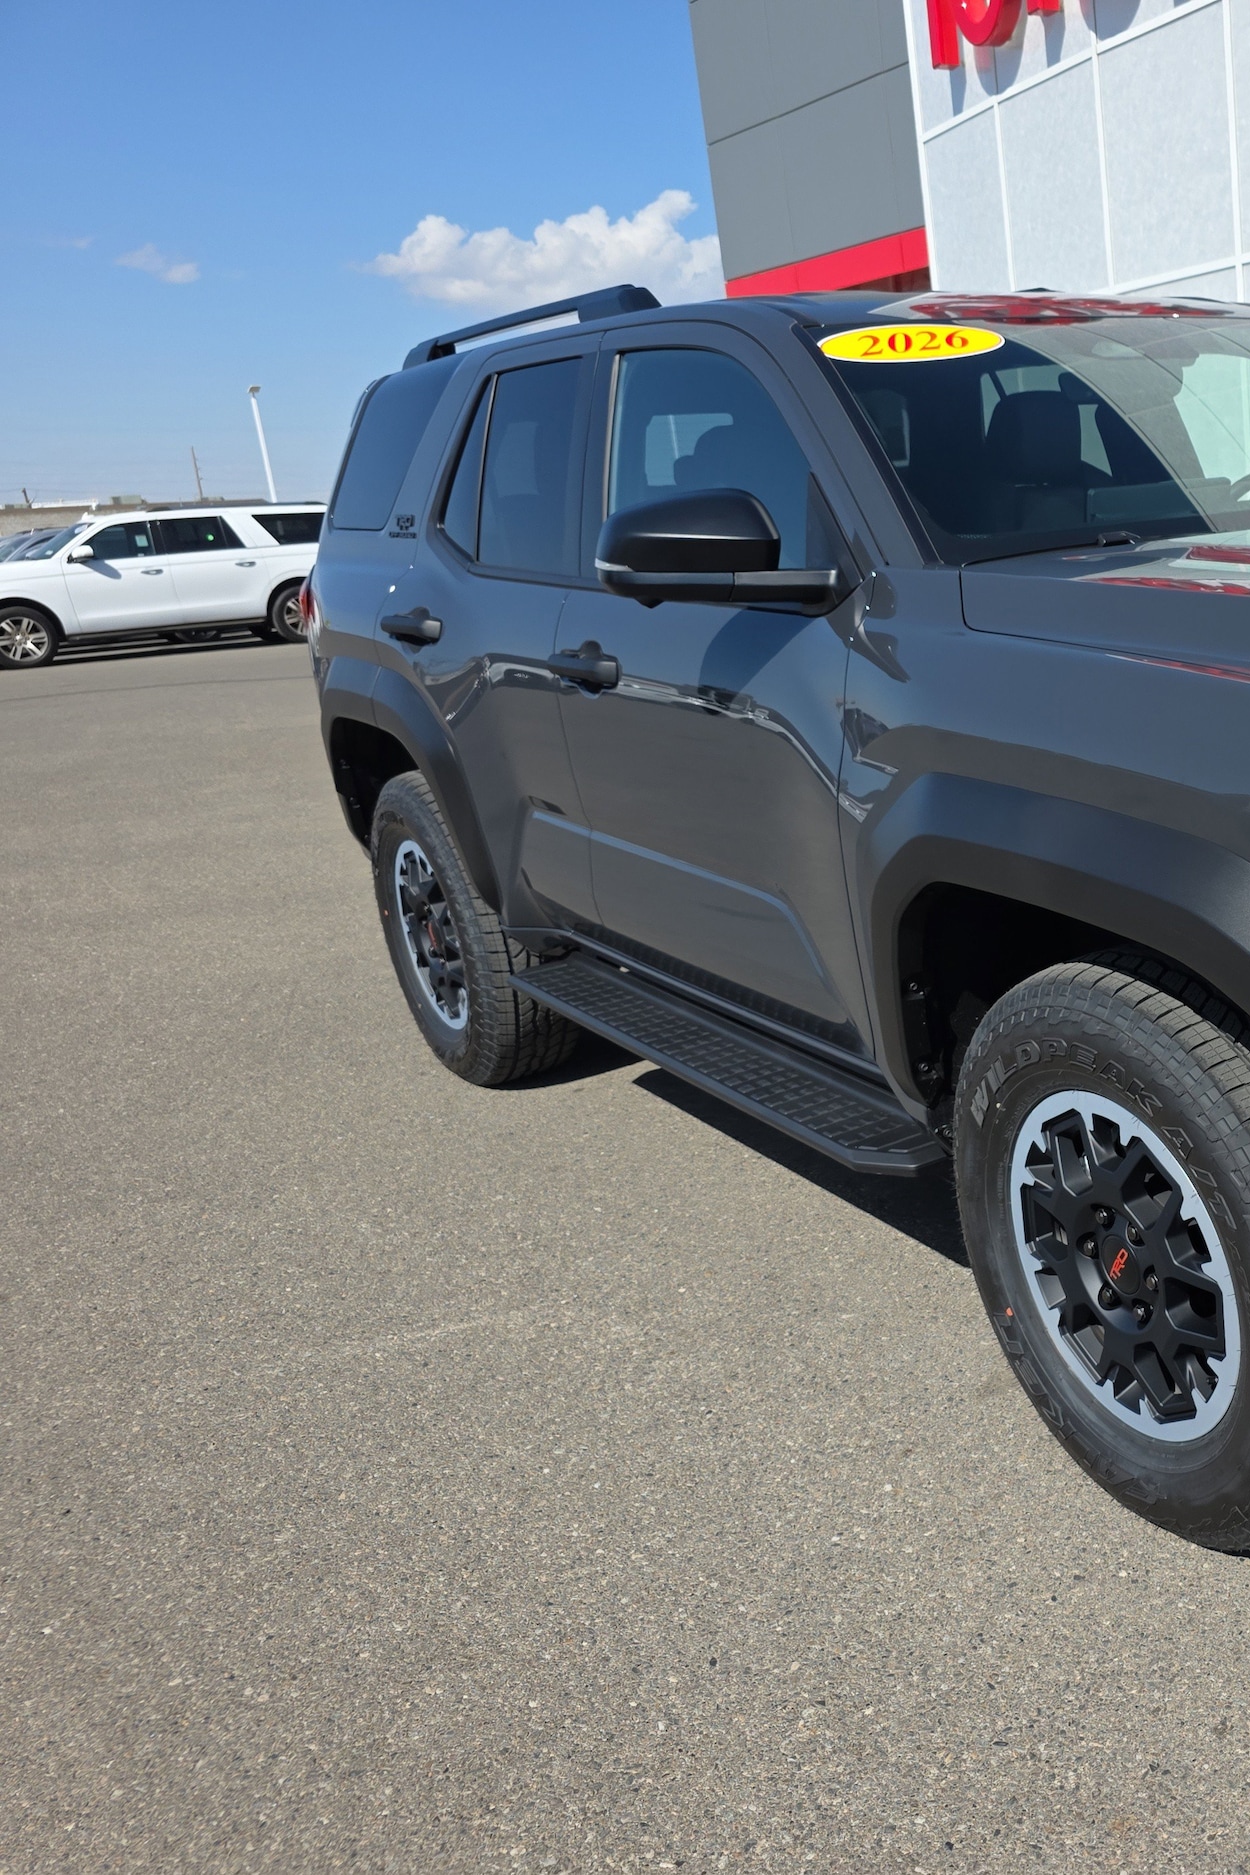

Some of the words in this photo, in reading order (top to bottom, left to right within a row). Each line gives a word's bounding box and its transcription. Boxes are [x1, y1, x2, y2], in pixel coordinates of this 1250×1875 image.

[858, 329, 969, 357] 2026
[969, 1037, 1164, 1129] WILDPEAK
[1110, 1248, 1128, 1279] TRD
